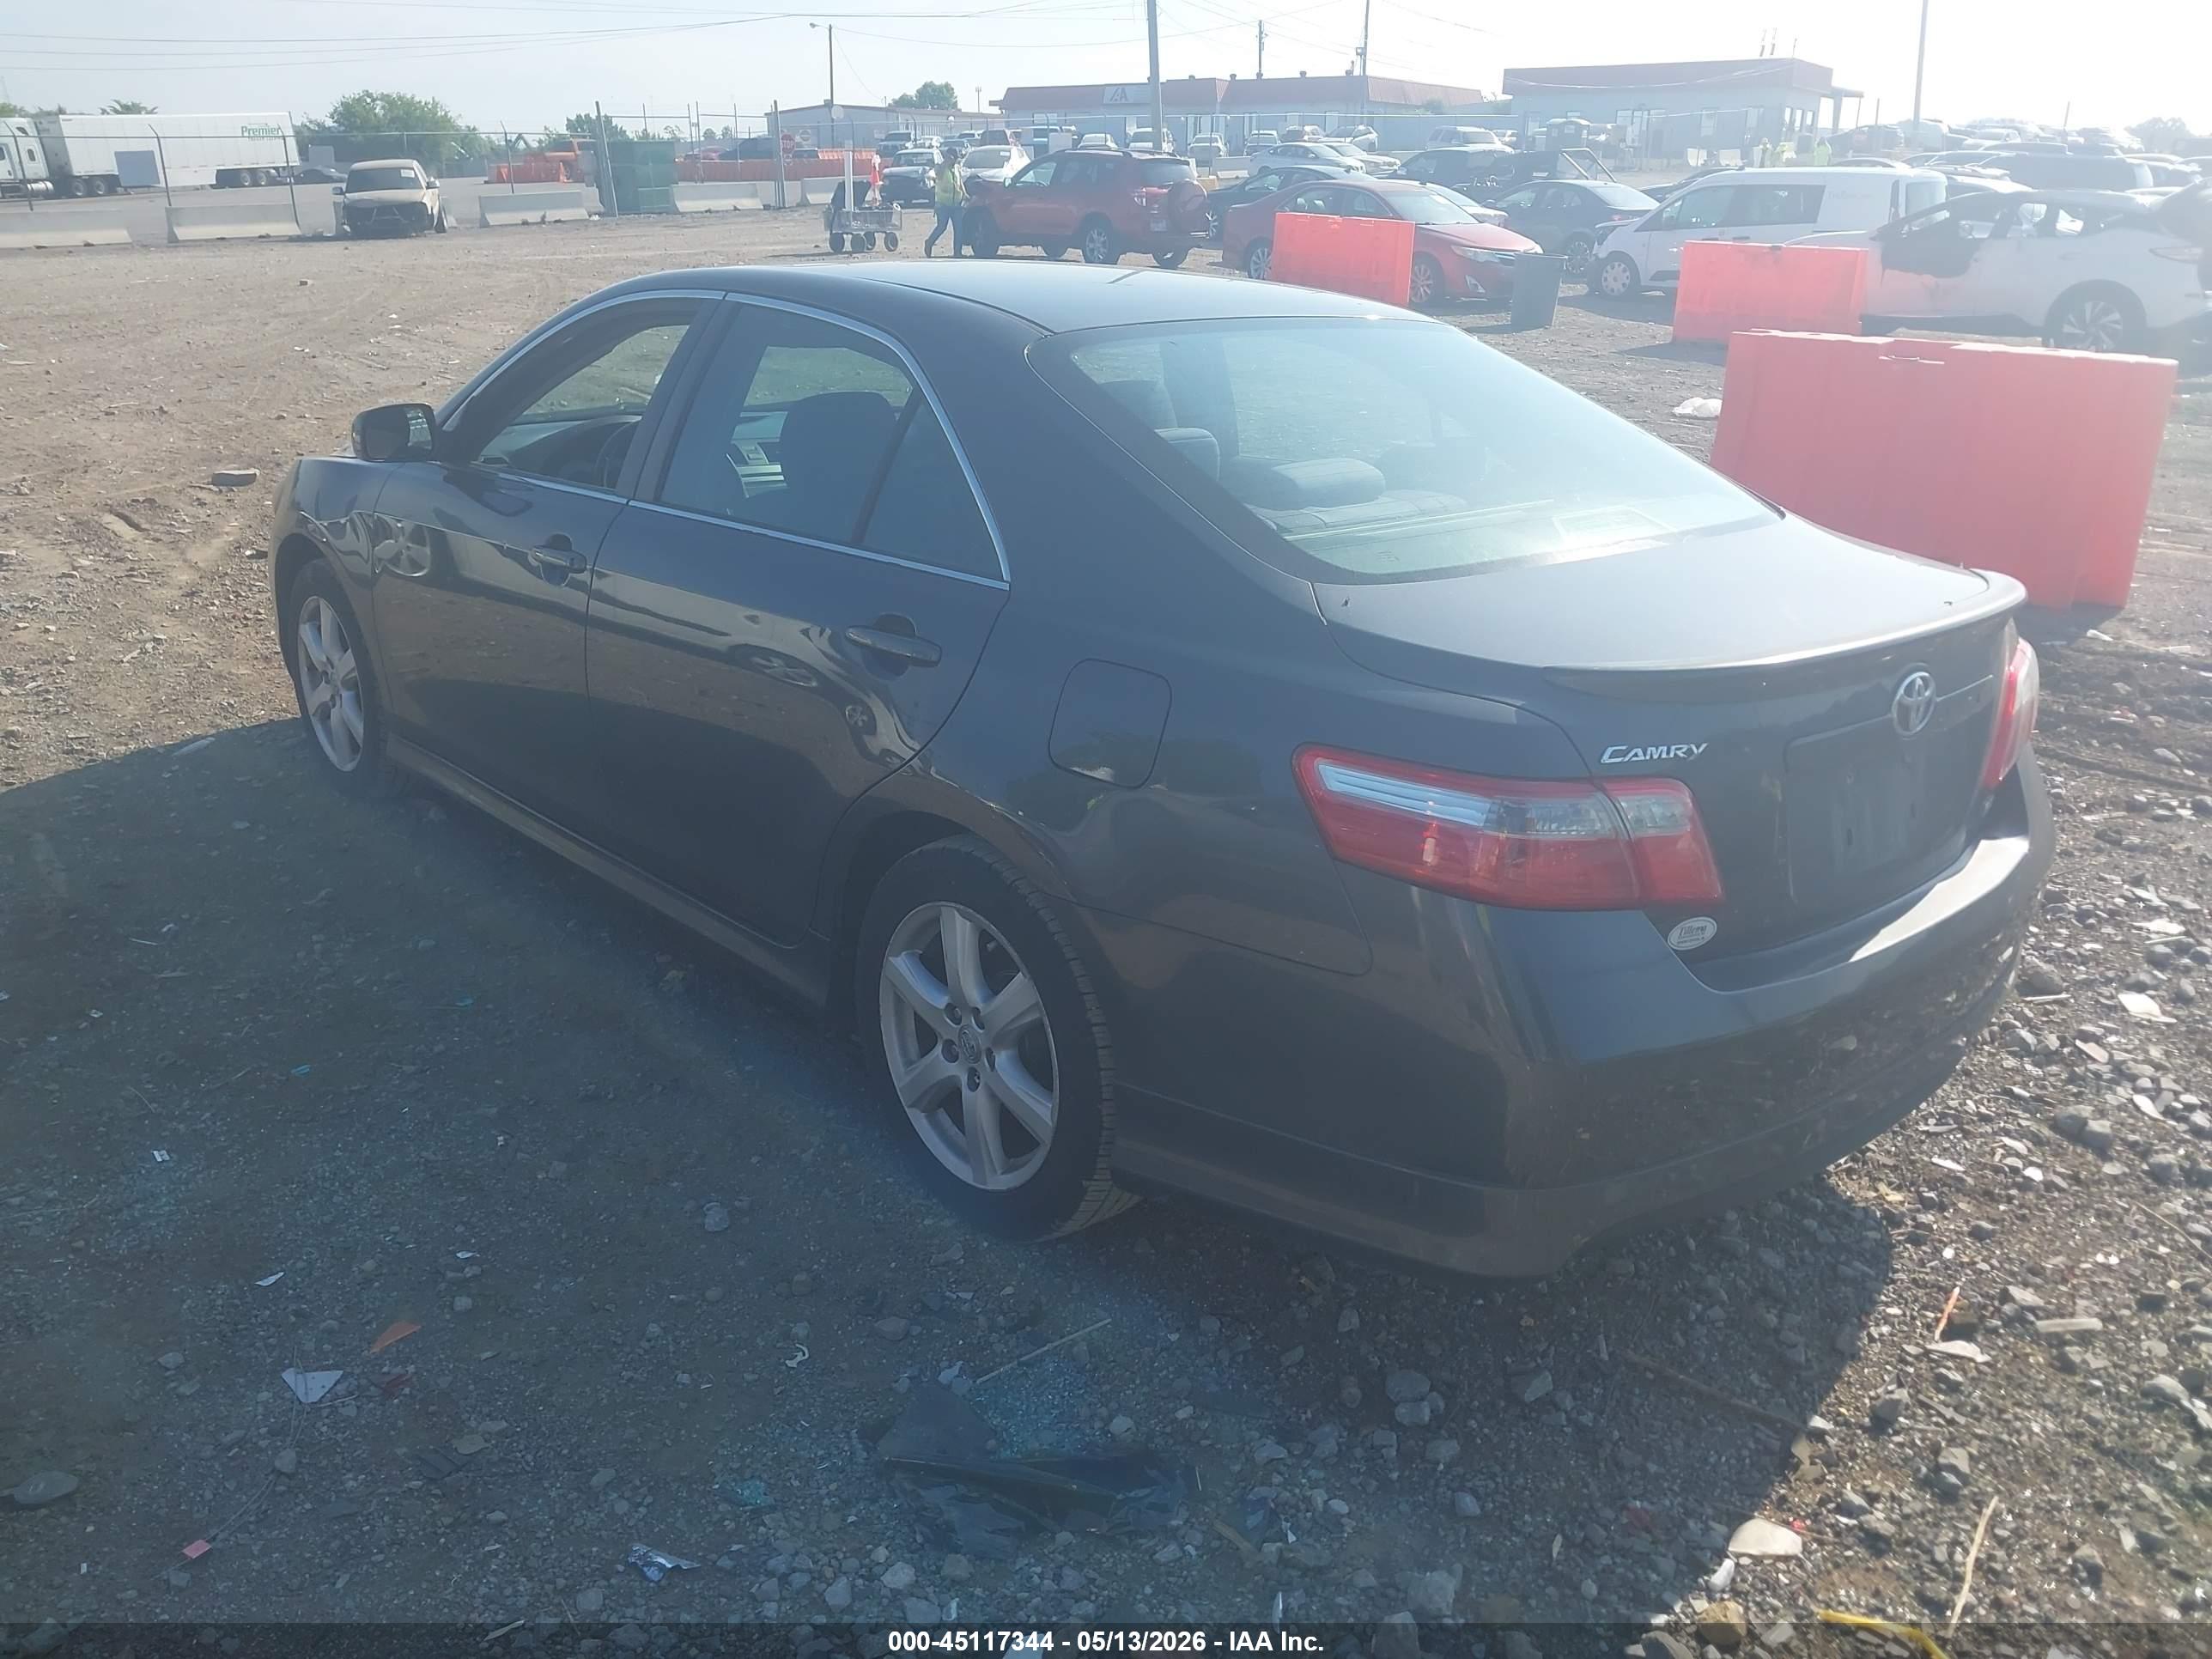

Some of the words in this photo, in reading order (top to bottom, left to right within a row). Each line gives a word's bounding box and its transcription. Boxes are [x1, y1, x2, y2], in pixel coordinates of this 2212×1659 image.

[241, 125, 283, 137] Premier
[781, 140, 794, 149] STOP
[1600, 743, 1708, 763] CAMRY
